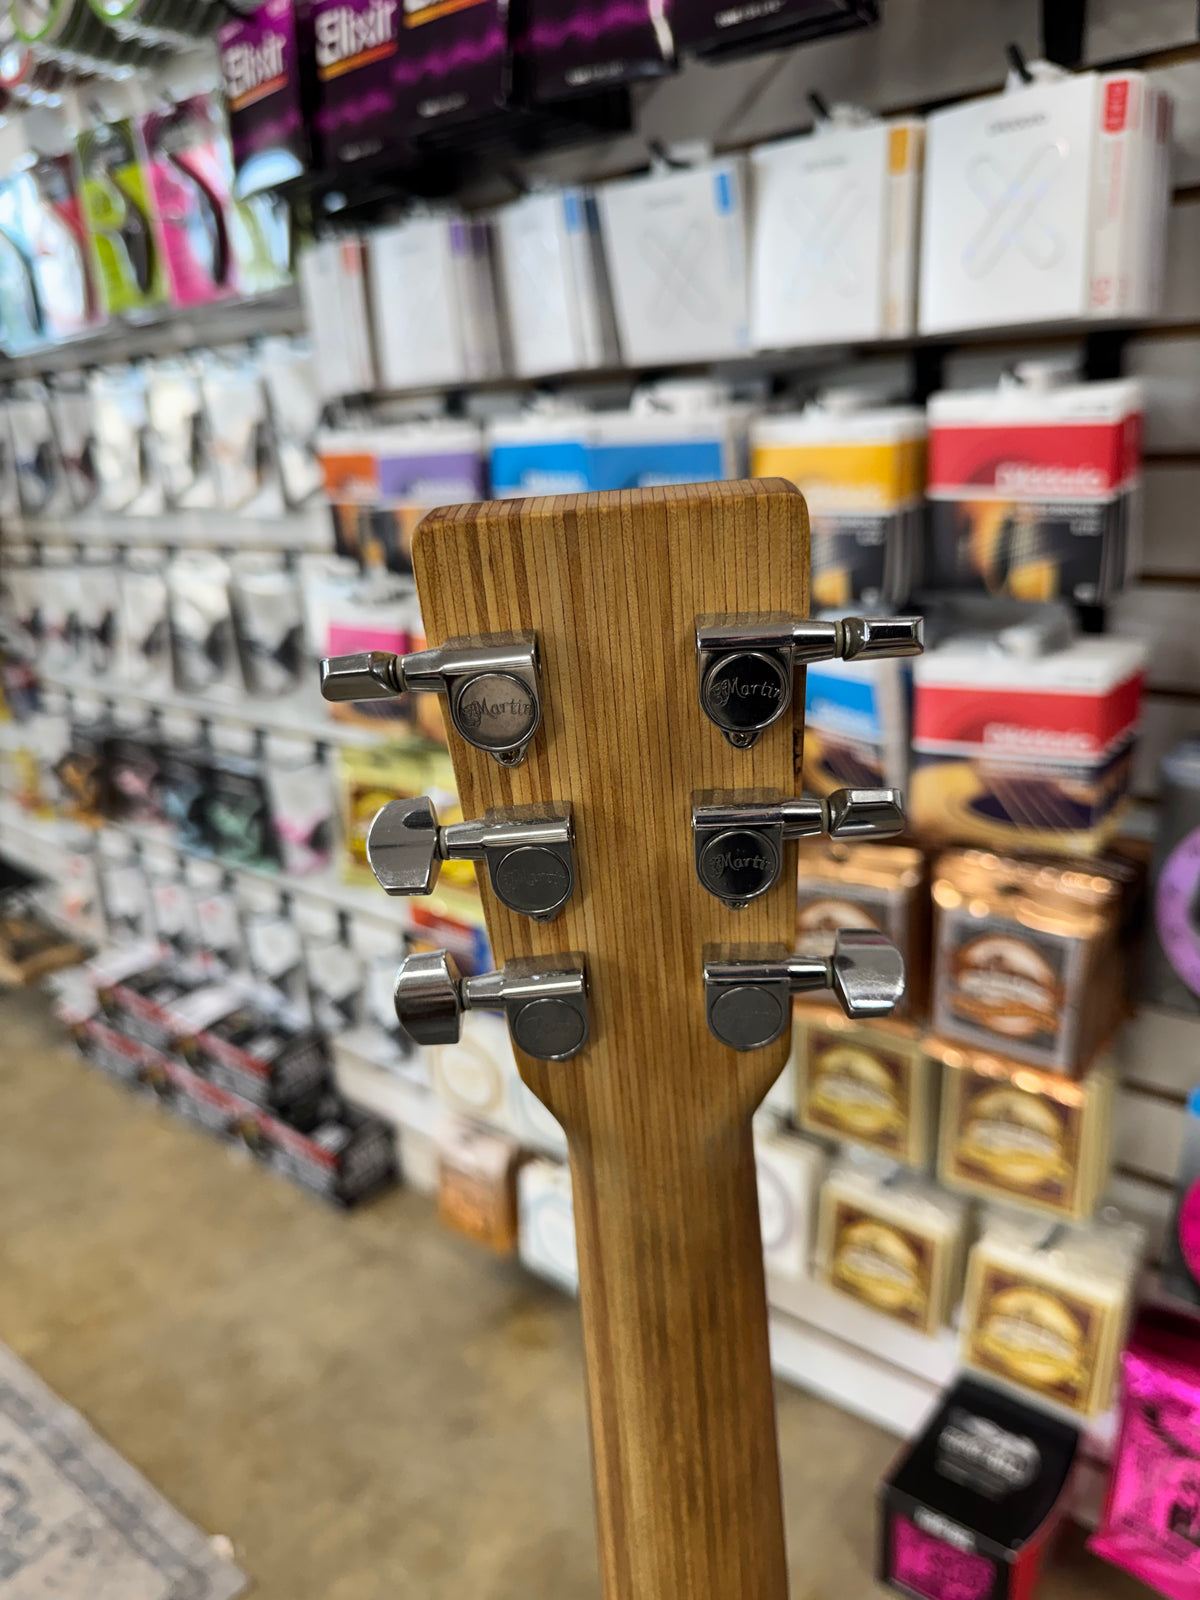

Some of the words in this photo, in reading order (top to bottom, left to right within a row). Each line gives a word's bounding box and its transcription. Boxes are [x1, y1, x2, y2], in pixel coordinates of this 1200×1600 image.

[315, 0, 397, 66] Elixir
[222, 31, 287, 98] Elixir
[470, 697, 534, 728] Martin
[720, 676, 784, 707] Martin
